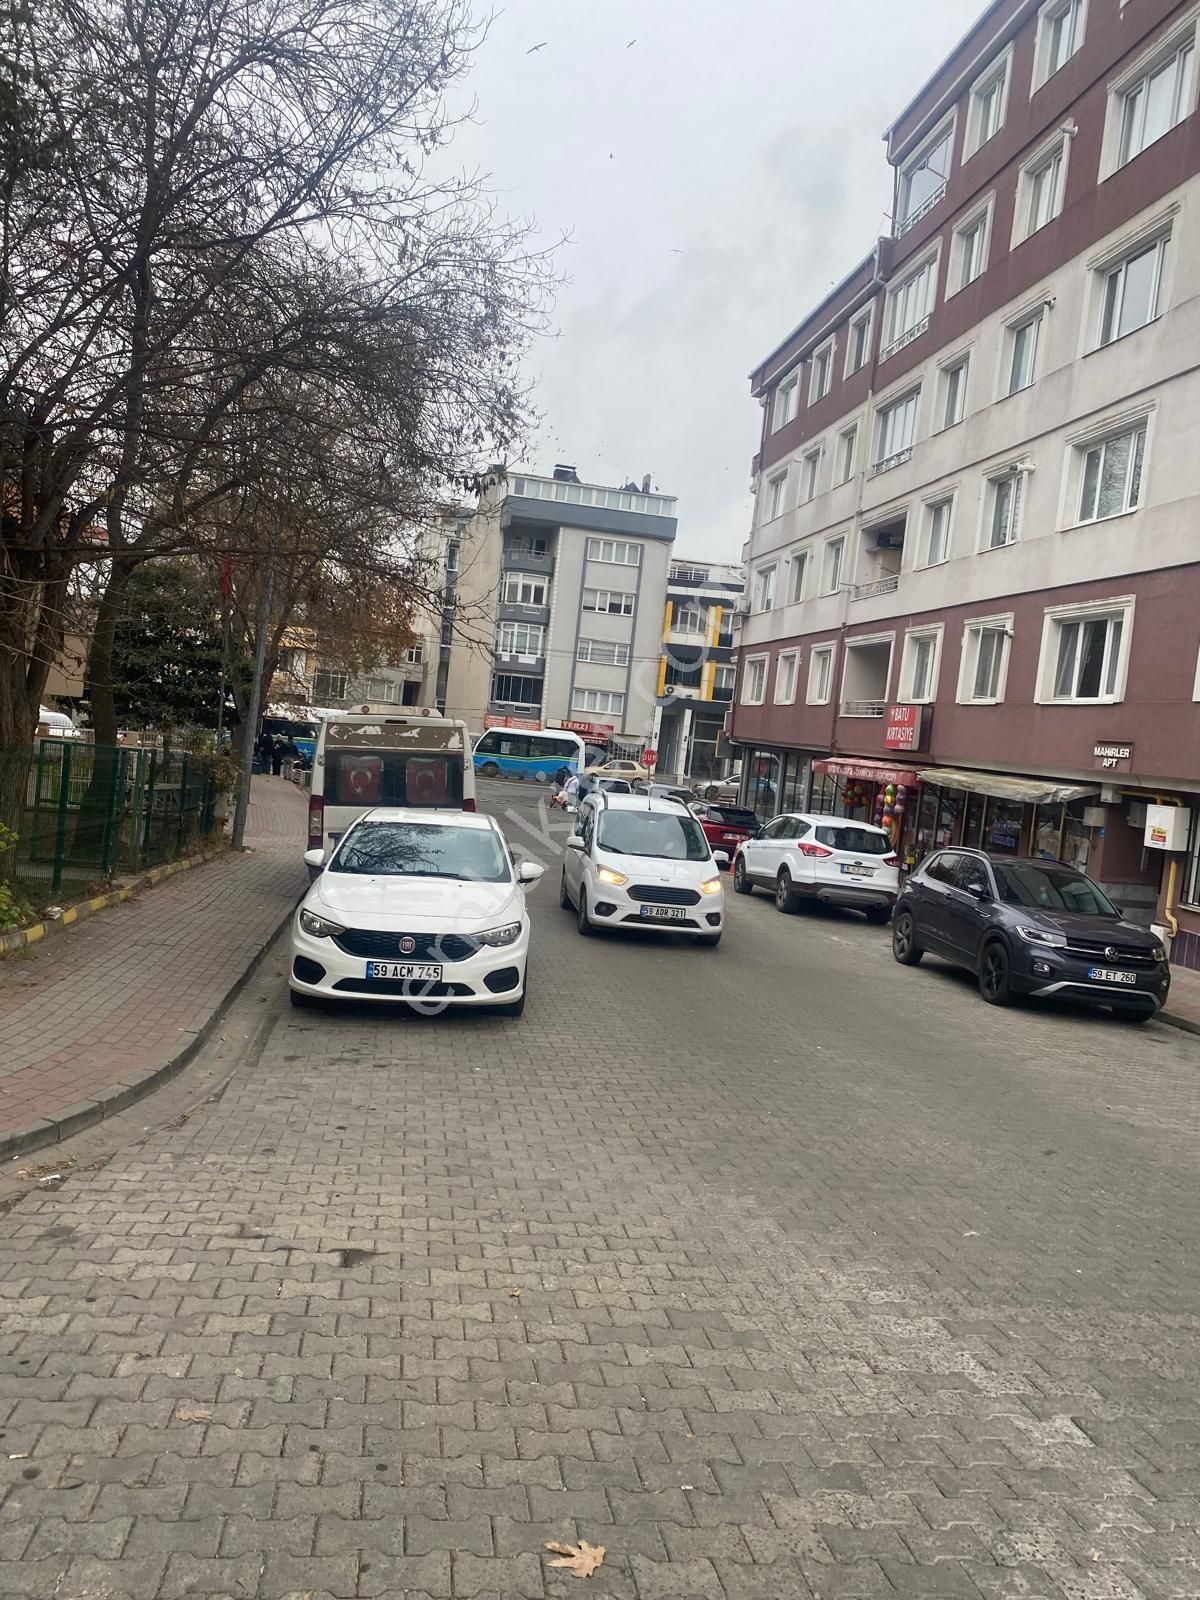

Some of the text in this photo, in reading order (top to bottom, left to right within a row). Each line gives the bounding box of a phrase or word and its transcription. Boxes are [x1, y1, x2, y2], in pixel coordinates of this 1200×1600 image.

[894, 707, 910, 721] BATU
[1102, 758, 1117, 767] APT
[671, 909, 684, 917] 321
[373, 964, 388, 977] 59
[418, 966, 440, 979] 745
[1092, 969, 1135, 983] 59 ET 260
